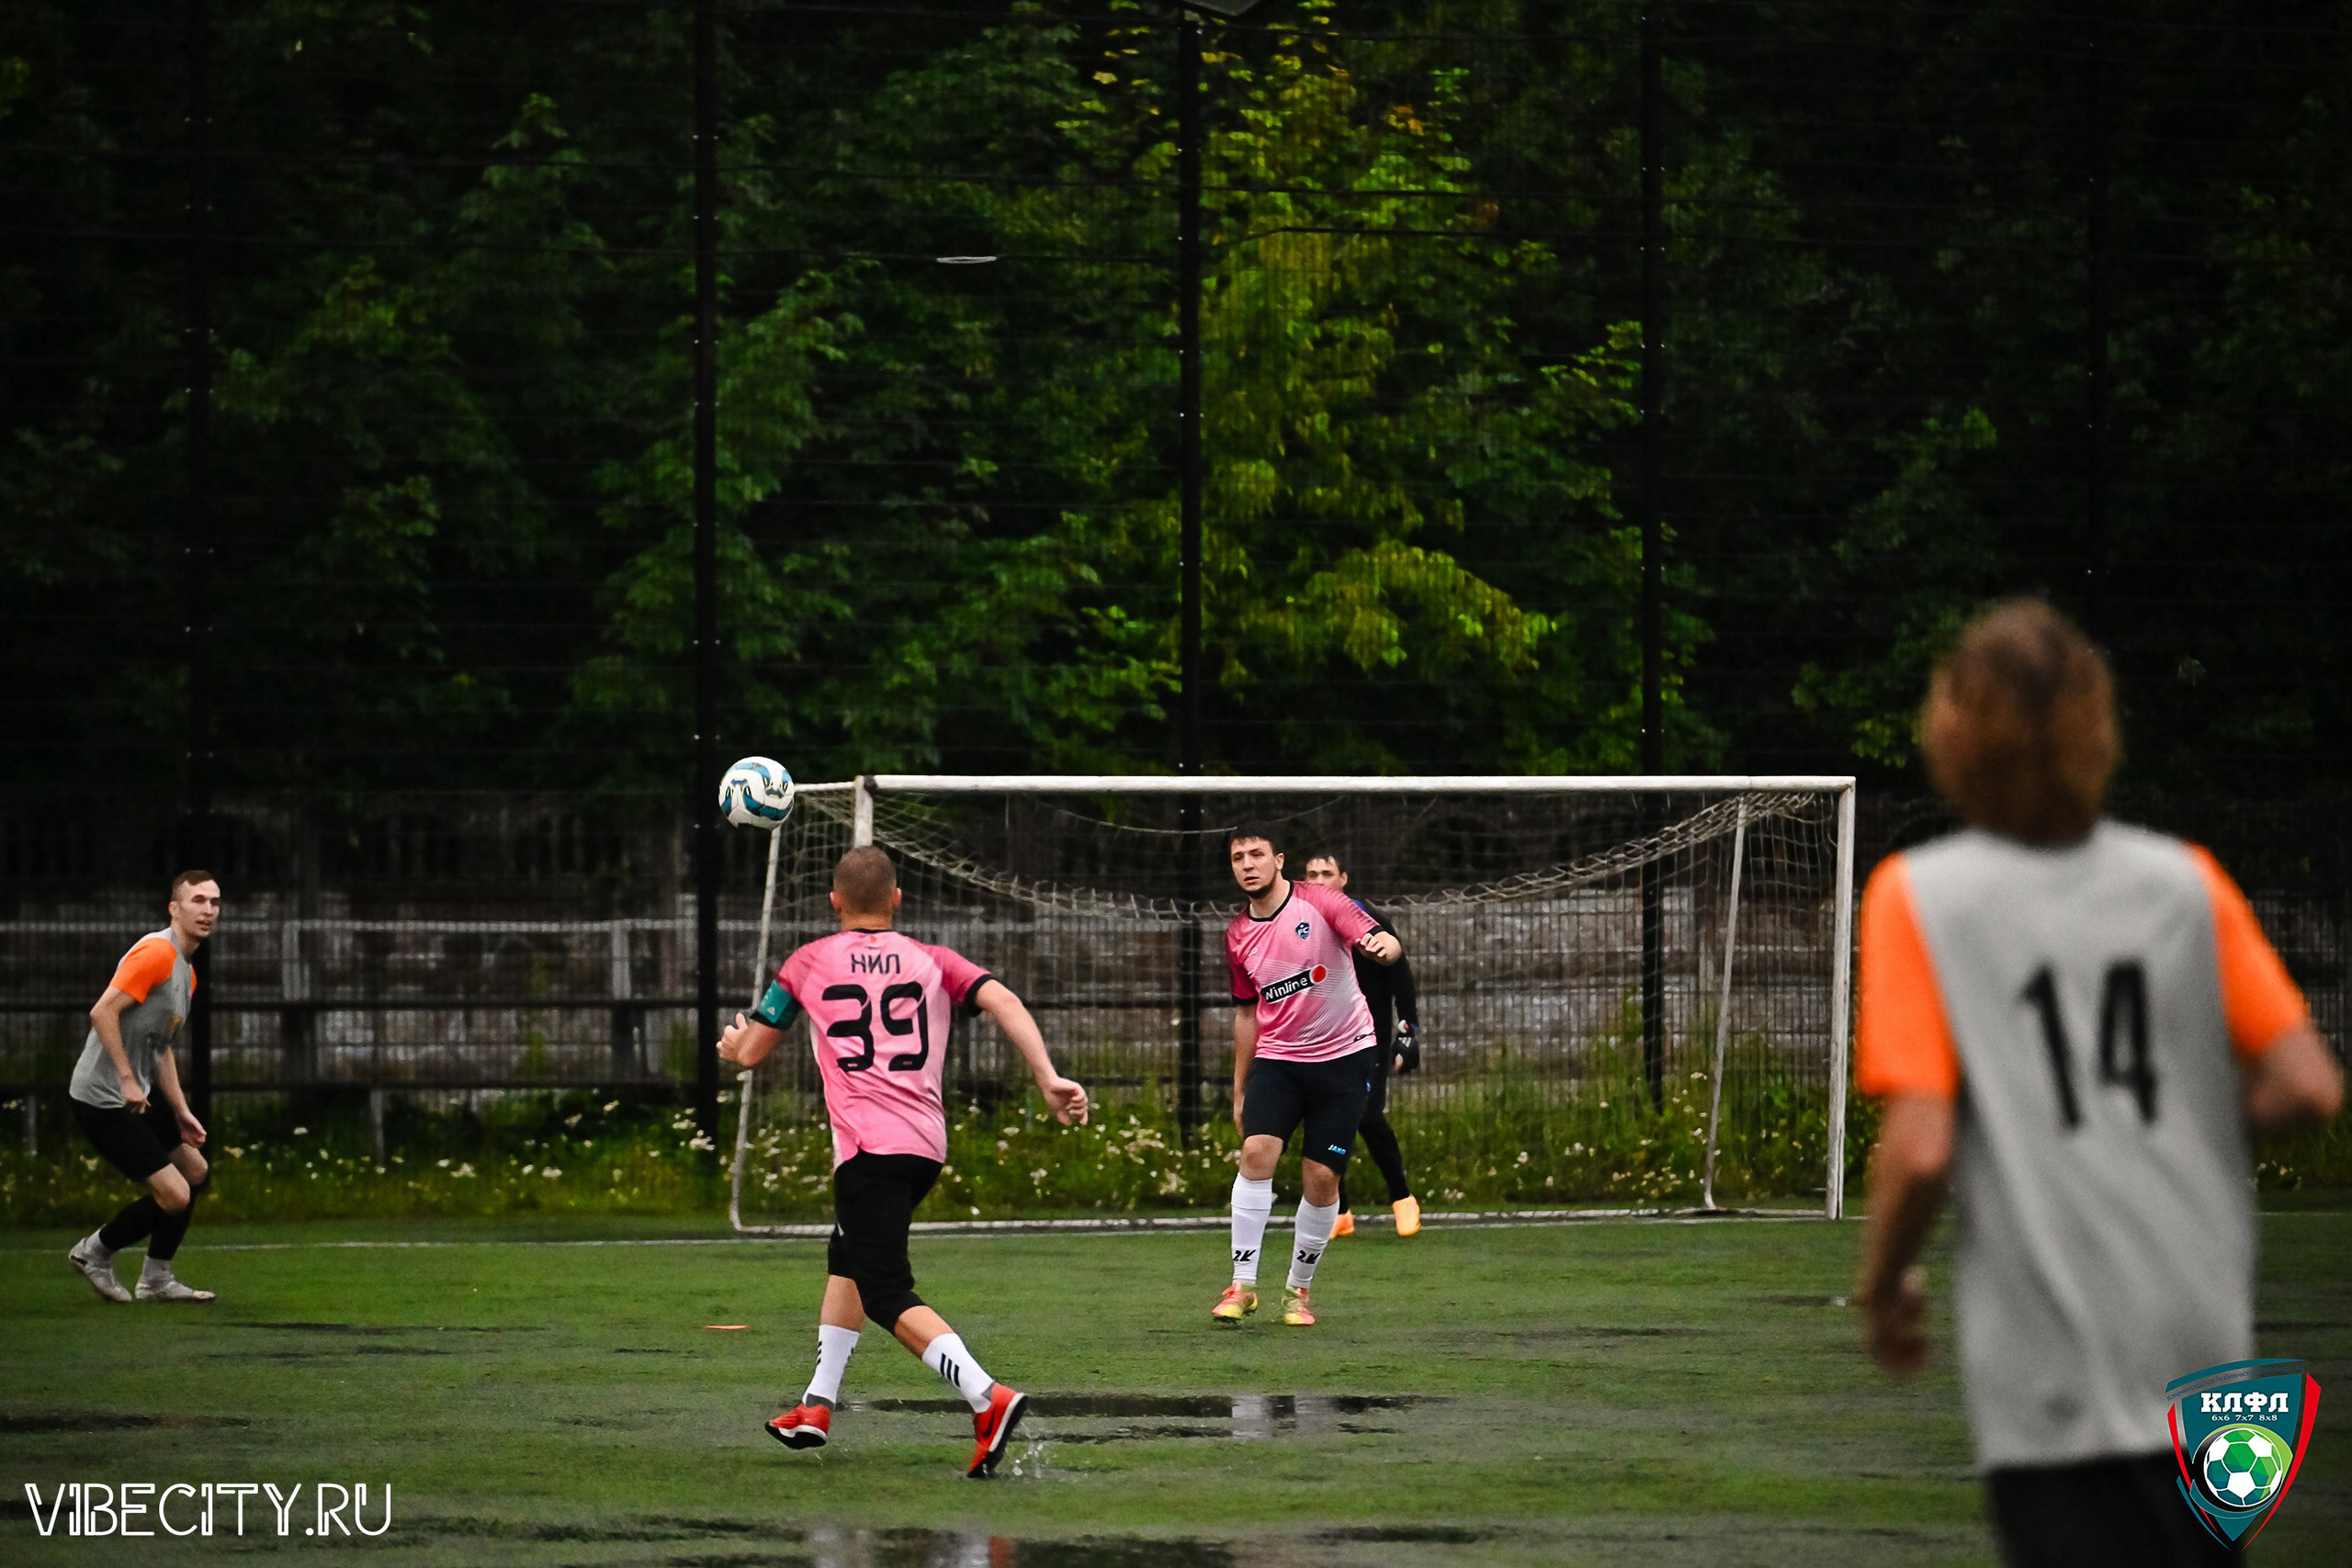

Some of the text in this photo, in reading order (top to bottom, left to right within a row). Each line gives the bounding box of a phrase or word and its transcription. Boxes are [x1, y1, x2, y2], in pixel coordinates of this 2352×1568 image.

[851, 953, 900, 974] НИЛ
[822, 981, 929, 1072] 39
[2018, 960, 2160, 1128] 14
[1233, 1249, 1257, 1261] 2K
[1296, 1250, 1320, 1264] 2K
